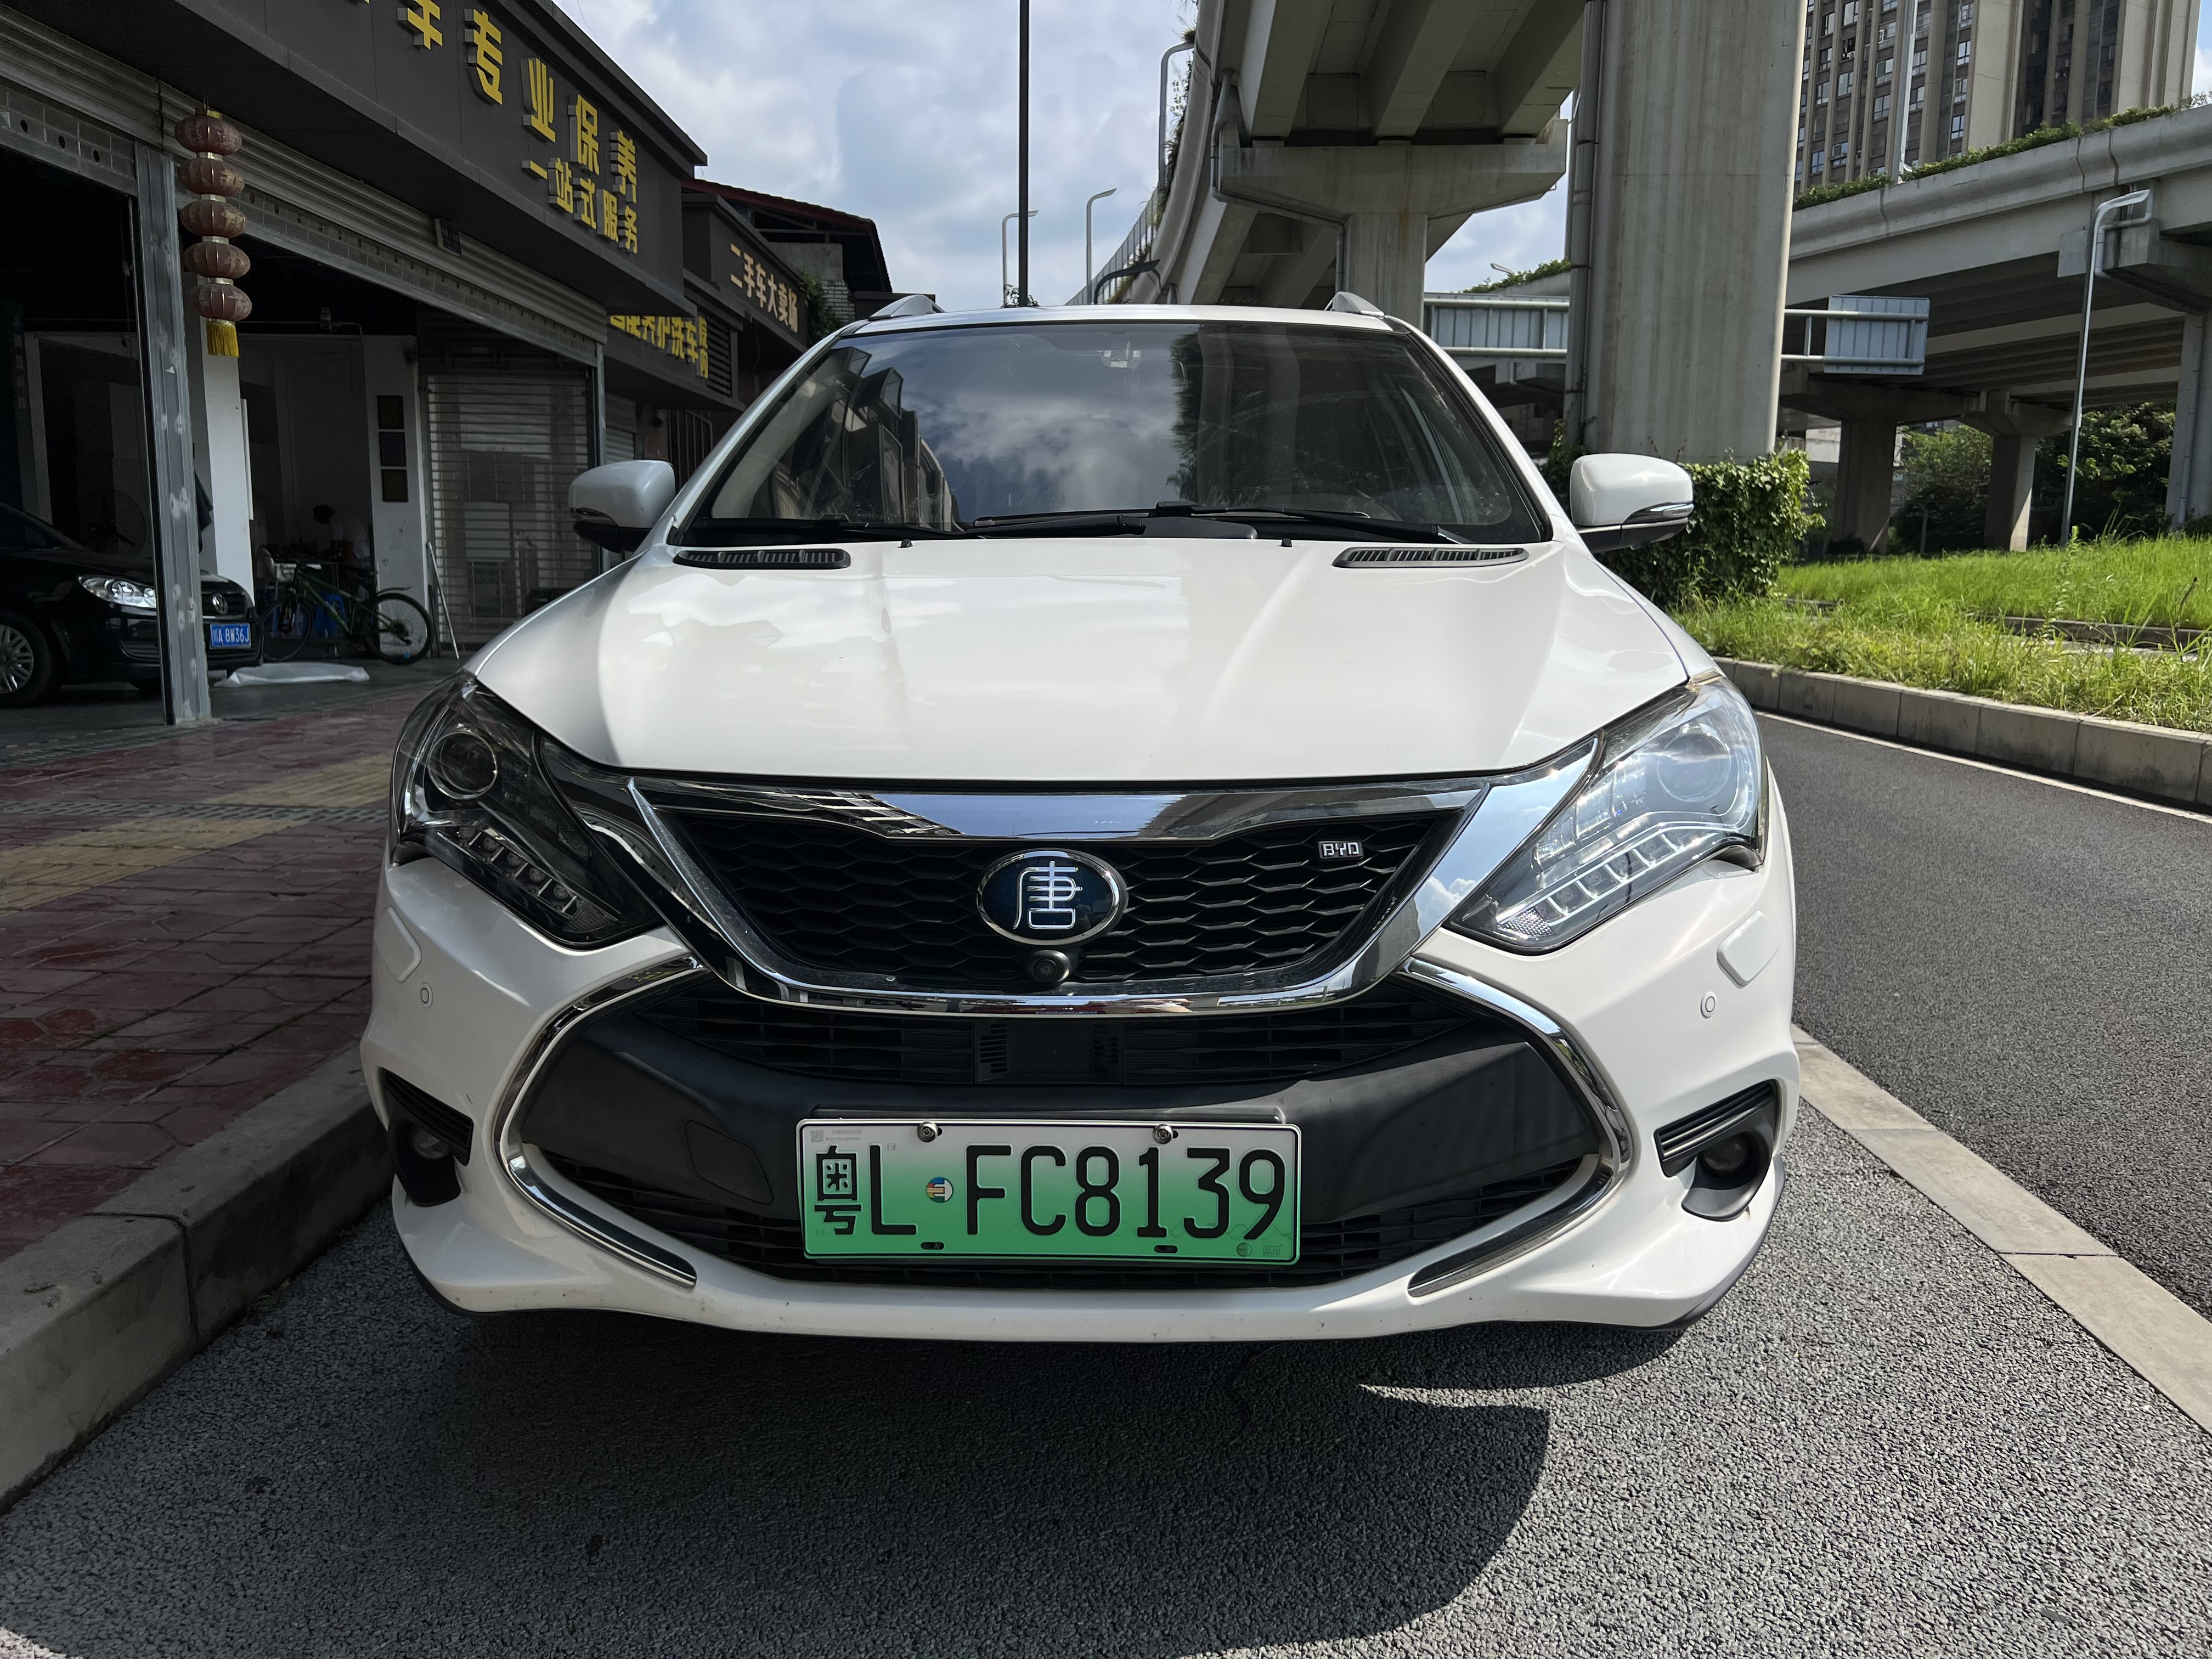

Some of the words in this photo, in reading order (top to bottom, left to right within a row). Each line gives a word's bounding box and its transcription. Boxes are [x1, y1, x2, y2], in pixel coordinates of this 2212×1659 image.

[529, 157, 637, 253] 一站式服务
[730, 243, 798, 333] 二手车大卖场
[1323, 842, 1359, 856] BYD
[1012, 860, 1083, 930] 唐
[966, 1145, 1286, 1240] FC8139
